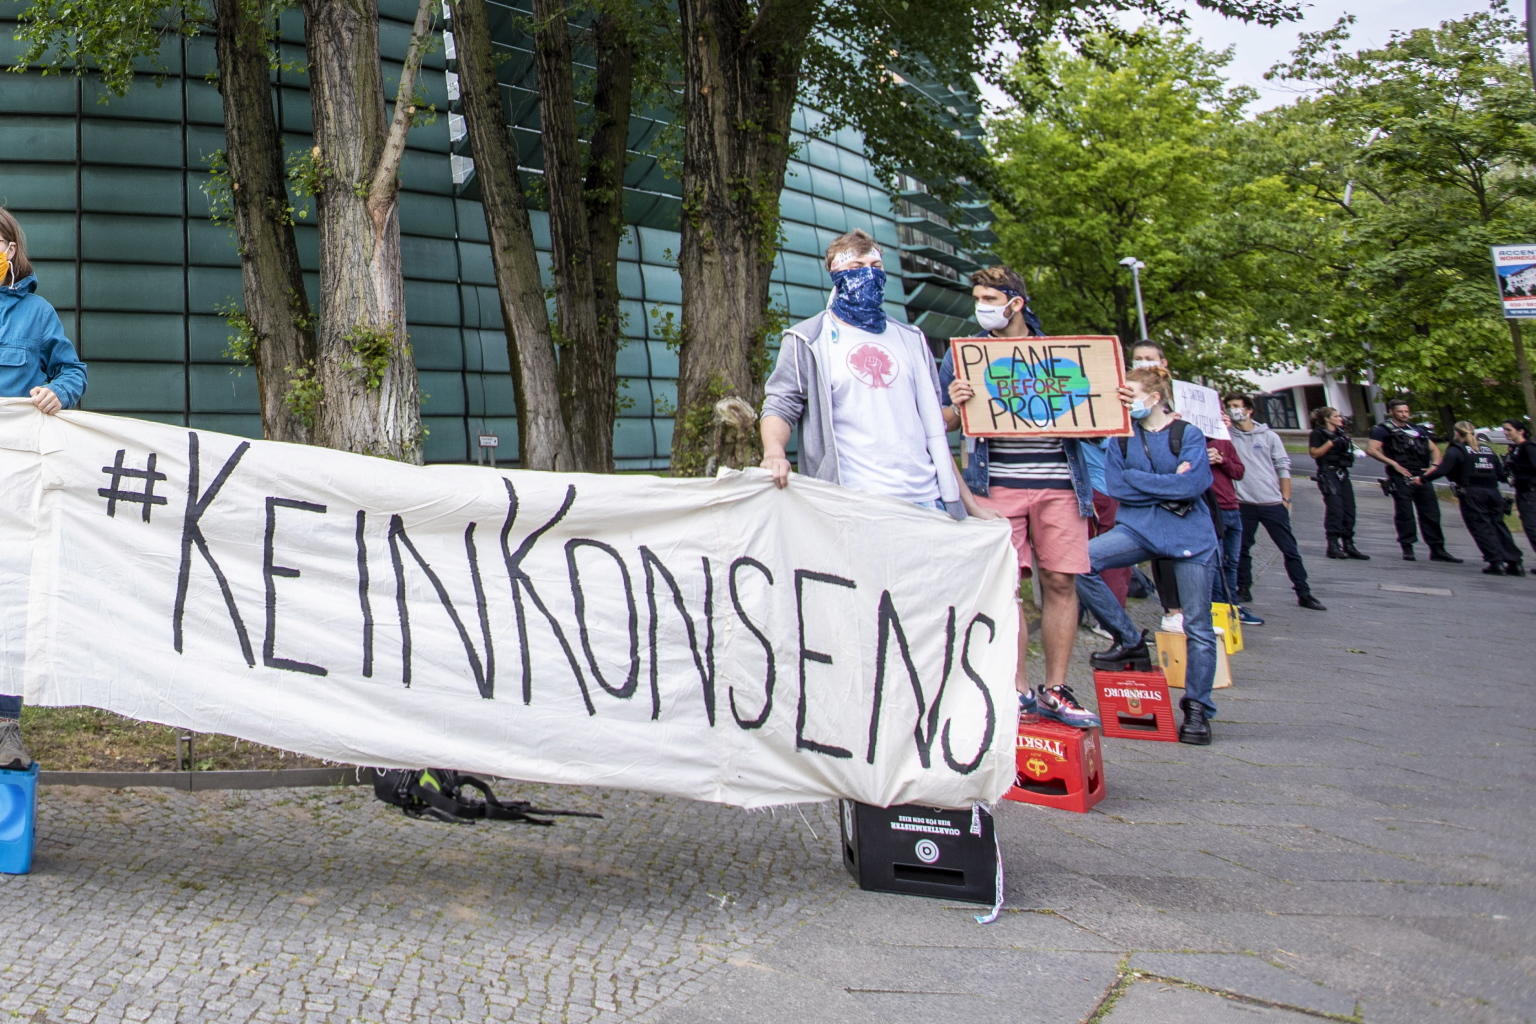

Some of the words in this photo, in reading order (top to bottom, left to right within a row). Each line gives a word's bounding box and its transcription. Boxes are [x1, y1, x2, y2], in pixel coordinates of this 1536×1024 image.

[961, 344, 1091, 380] PLANET
[997, 378, 1072, 397] BEFORE
[988, 394, 1101, 430] PROFIT
[97, 431, 997, 776] #KEINKONSENS
[1104, 687, 1162, 701] STERNBURG
[1016, 735, 1064, 757] TYSKI
[890, 822, 960, 835] QUARTIERMEISTER
